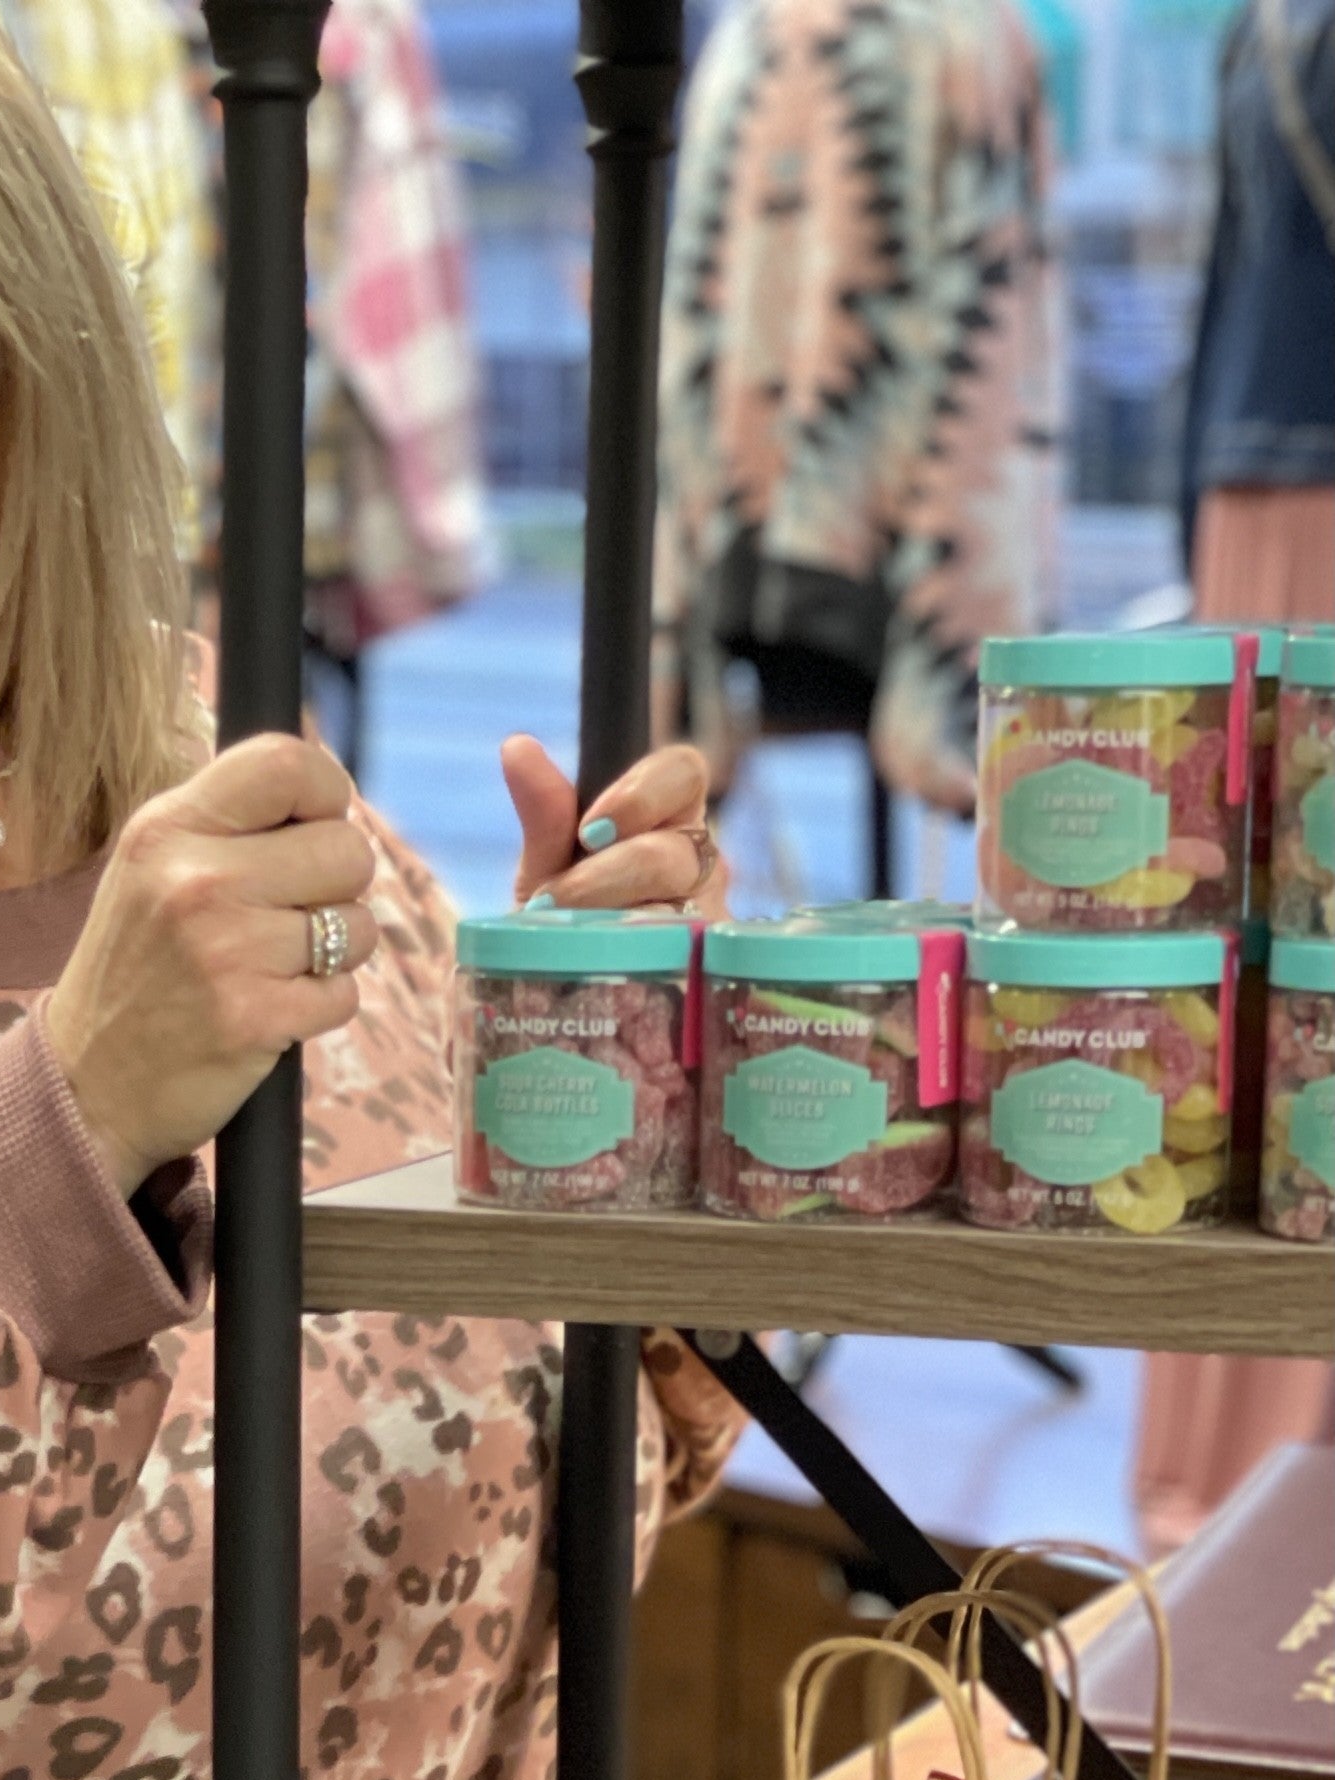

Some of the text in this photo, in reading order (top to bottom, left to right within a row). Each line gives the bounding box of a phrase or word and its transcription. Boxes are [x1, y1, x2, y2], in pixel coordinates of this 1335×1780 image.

[1093, 729, 1150, 749] CLUB
[494, 1016, 617, 1036] CANDY CLUB
[744, 1015, 871, 1036] CANDY CLUB
[1014, 1027, 1146, 1049] CANDY CLUB
